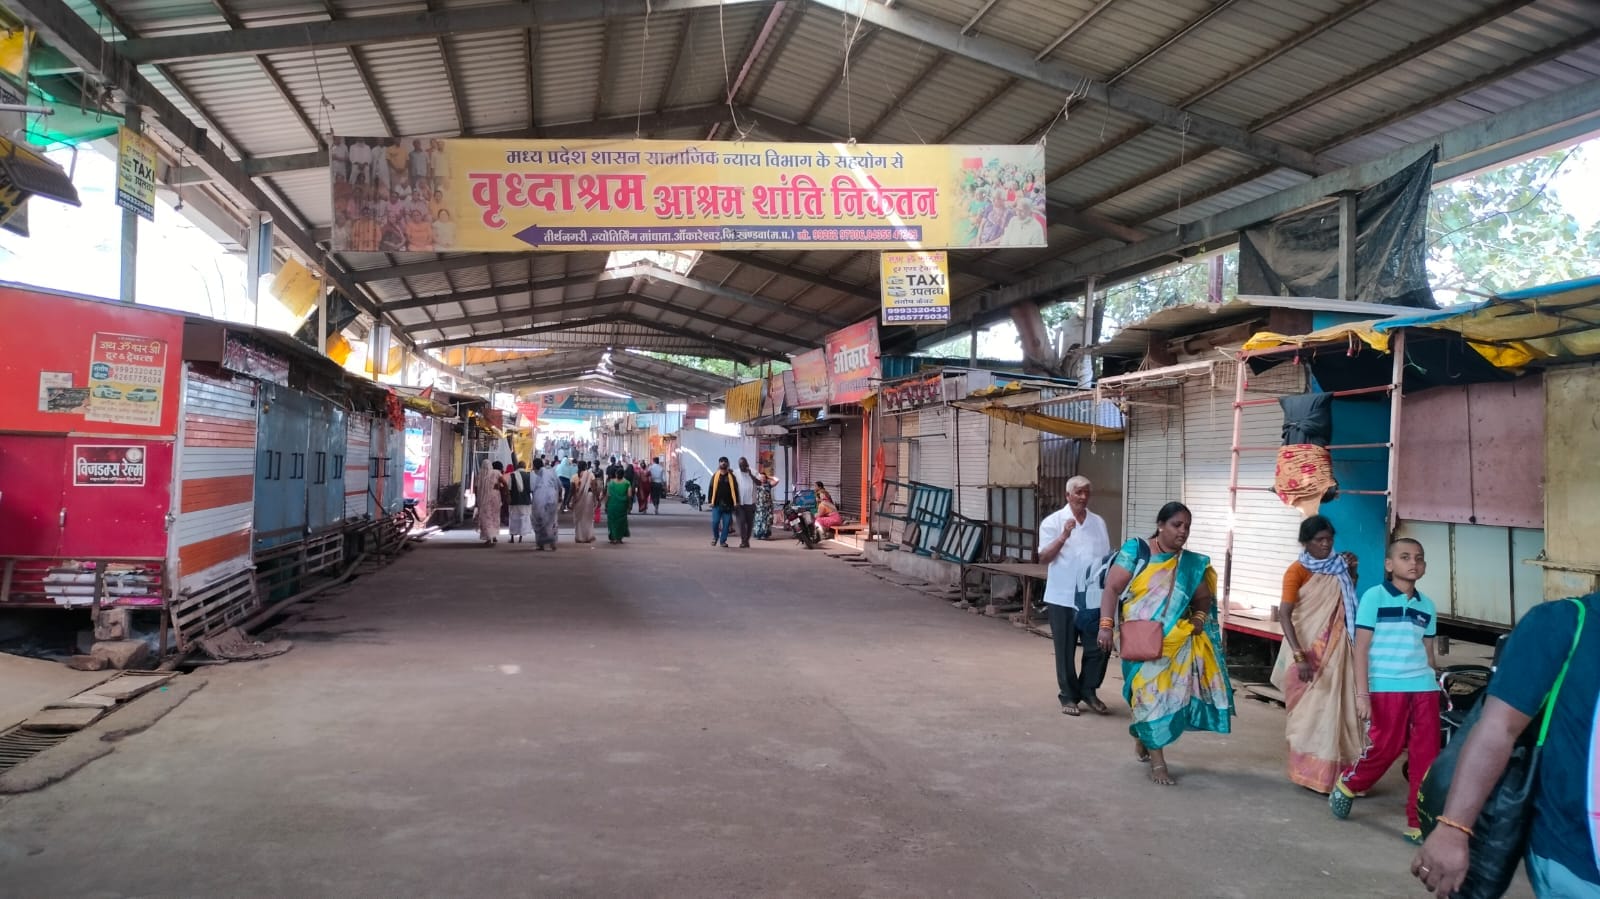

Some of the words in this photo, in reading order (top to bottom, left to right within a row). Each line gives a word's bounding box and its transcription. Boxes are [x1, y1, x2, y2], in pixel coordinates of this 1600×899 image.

[506, 150, 543, 164] मध्य
[547, 146, 587, 166] प्रदेश
[591, 151, 641, 165] शासन
[645, 147, 720, 166] सामाजिक
[723, 153, 762, 167] न्याय
[765, 149, 813, 168] विभाग
[816, 150, 831, 168] के
[834, 151, 887, 169] सहयोग
[890, 151, 904, 169] से
[133, 158, 155, 183] TAXI
[653, 185, 745, 219] आश्रम
[751, 173, 825, 219] शांति
[831, 174, 939, 219] निकेतन
[906, 274, 945, 286] TAXI
[910, 287, 944, 296] उपलब्ध
[887, 306, 949, 314] 9993320433
[887, 313, 949, 321] 6265775034
[77, 457, 121, 476] विजडम्स
[121, 458, 143, 477] रेल्म
